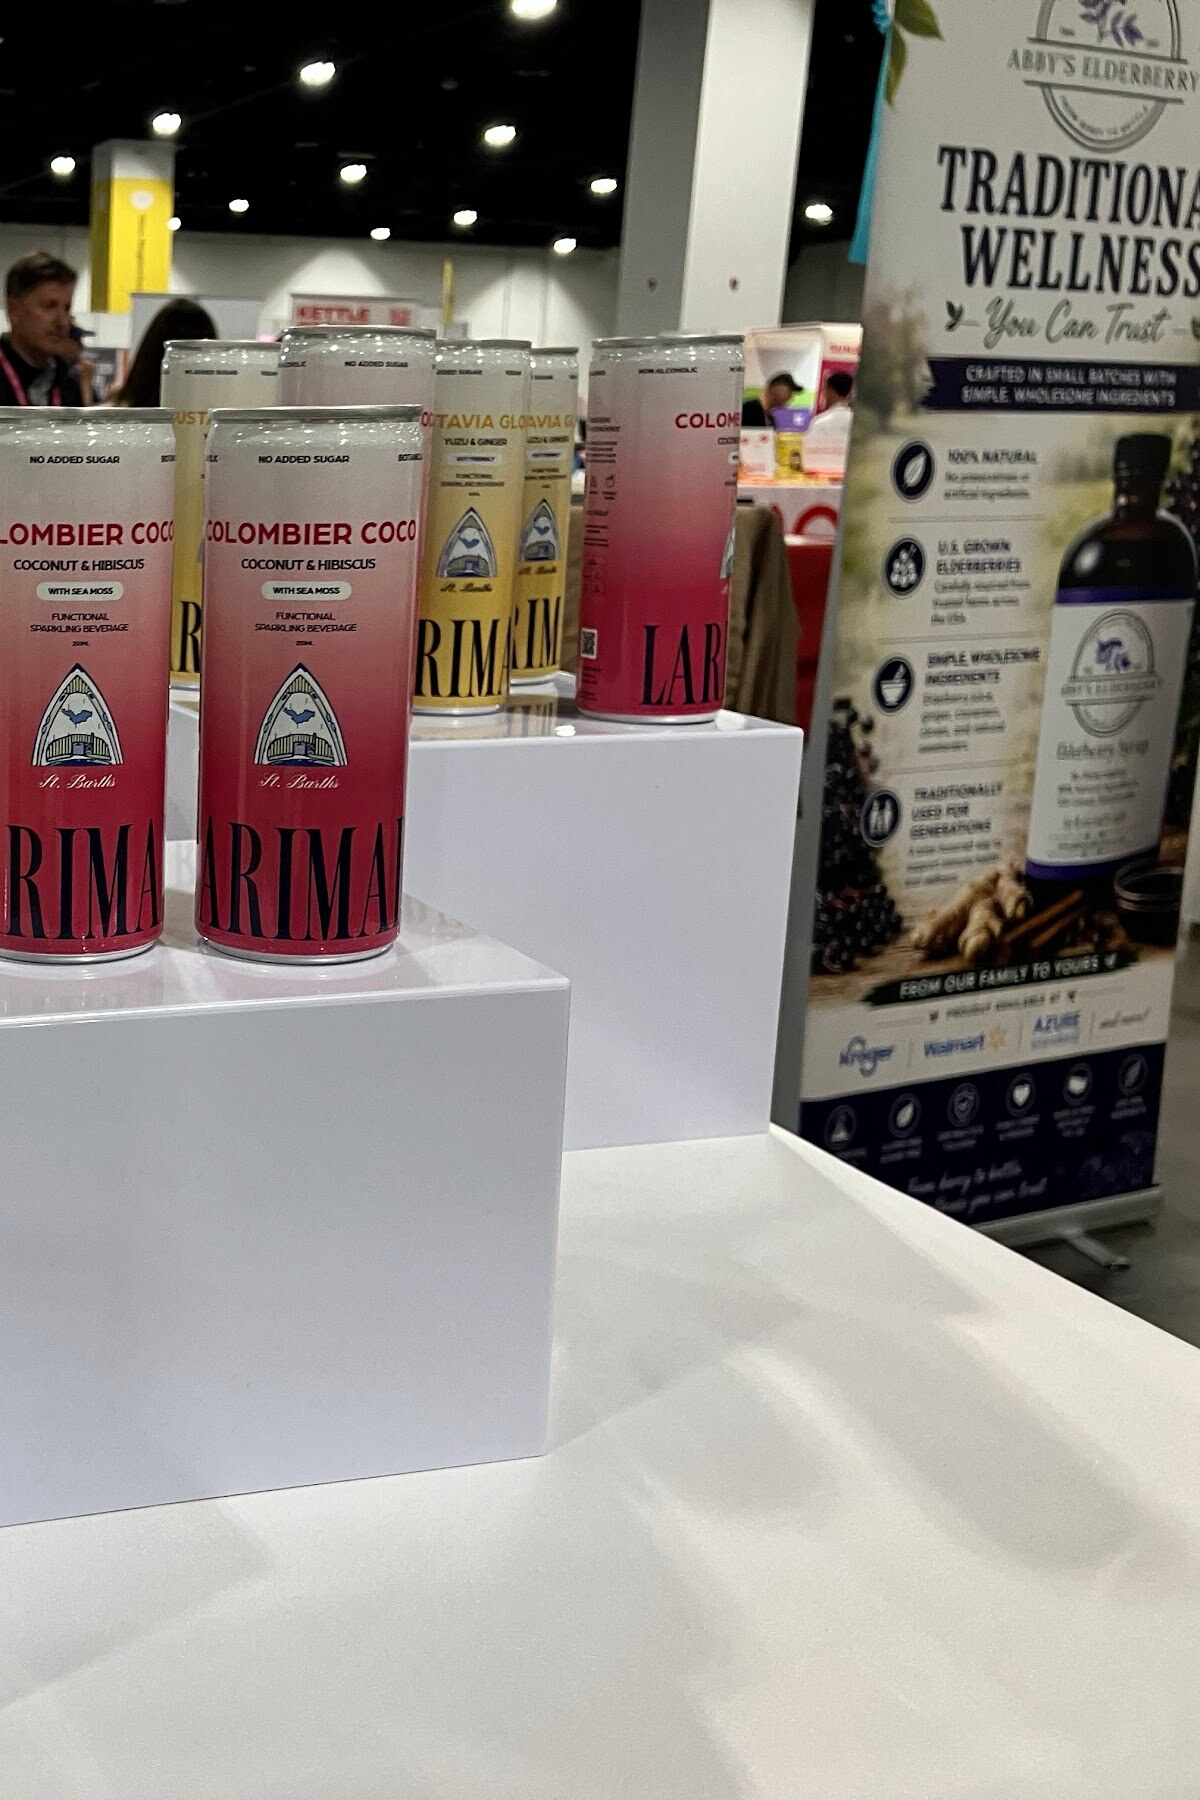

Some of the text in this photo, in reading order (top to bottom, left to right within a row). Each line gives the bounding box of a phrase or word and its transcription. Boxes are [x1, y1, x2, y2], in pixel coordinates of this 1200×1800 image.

[937, 144, 1200, 229] TRADITIONA
[960, 224, 1200, 298] WELLNESS
[983, 296, 1172, 349] You Can Trust
[437, 413, 494, 429] TAVIA
[29, 456, 120, 464] NO ADDED SUGAR
[258, 455, 349, 464] NO ADDED SUGAR
[360, 519, 416, 545] COCO
[13, 559, 145, 571] COCONUT & HIBISCUS
[241, 558, 376, 571] COCONUT & HIBISCUS
[48, 587, 114, 595] WITH SEA MOSS
[273, 586, 341, 595] WITH SEA MOSS
[52, 613, 109, 621] FUNCTIONAL
[276, 612, 335, 621] FUNCTIONAL
[83, 623, 129, 633] BEVERAGE
[307, 623, 357, 632] BEVERAGE
